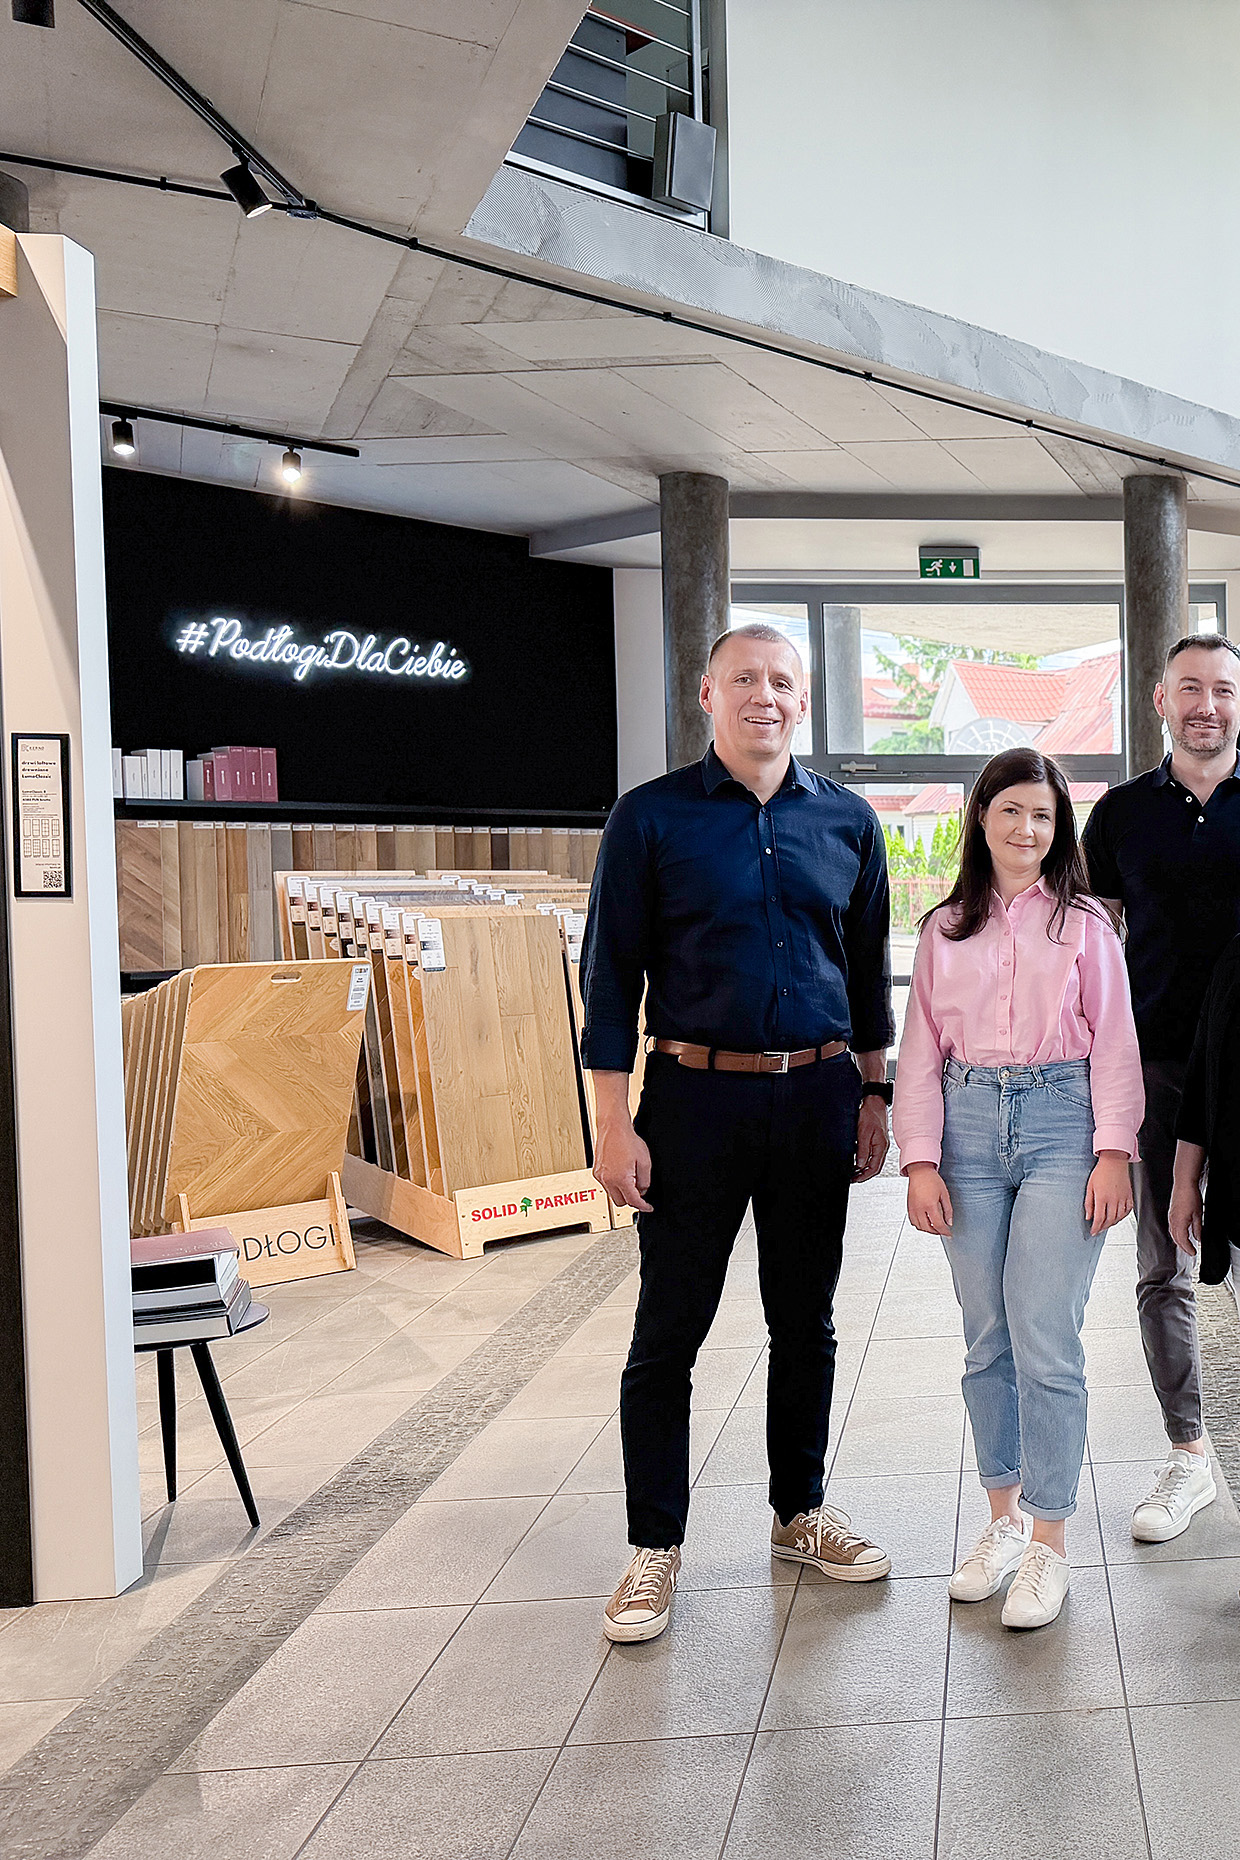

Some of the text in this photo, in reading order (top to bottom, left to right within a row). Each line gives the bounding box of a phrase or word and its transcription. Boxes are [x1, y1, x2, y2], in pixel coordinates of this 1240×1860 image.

[175, 616, 468, 682] #PodłogiDlaCiebie
[471, 1188, 597, 1222] SOLID PARKIET
[236, 1223, 336, 1262] DŁOGI
